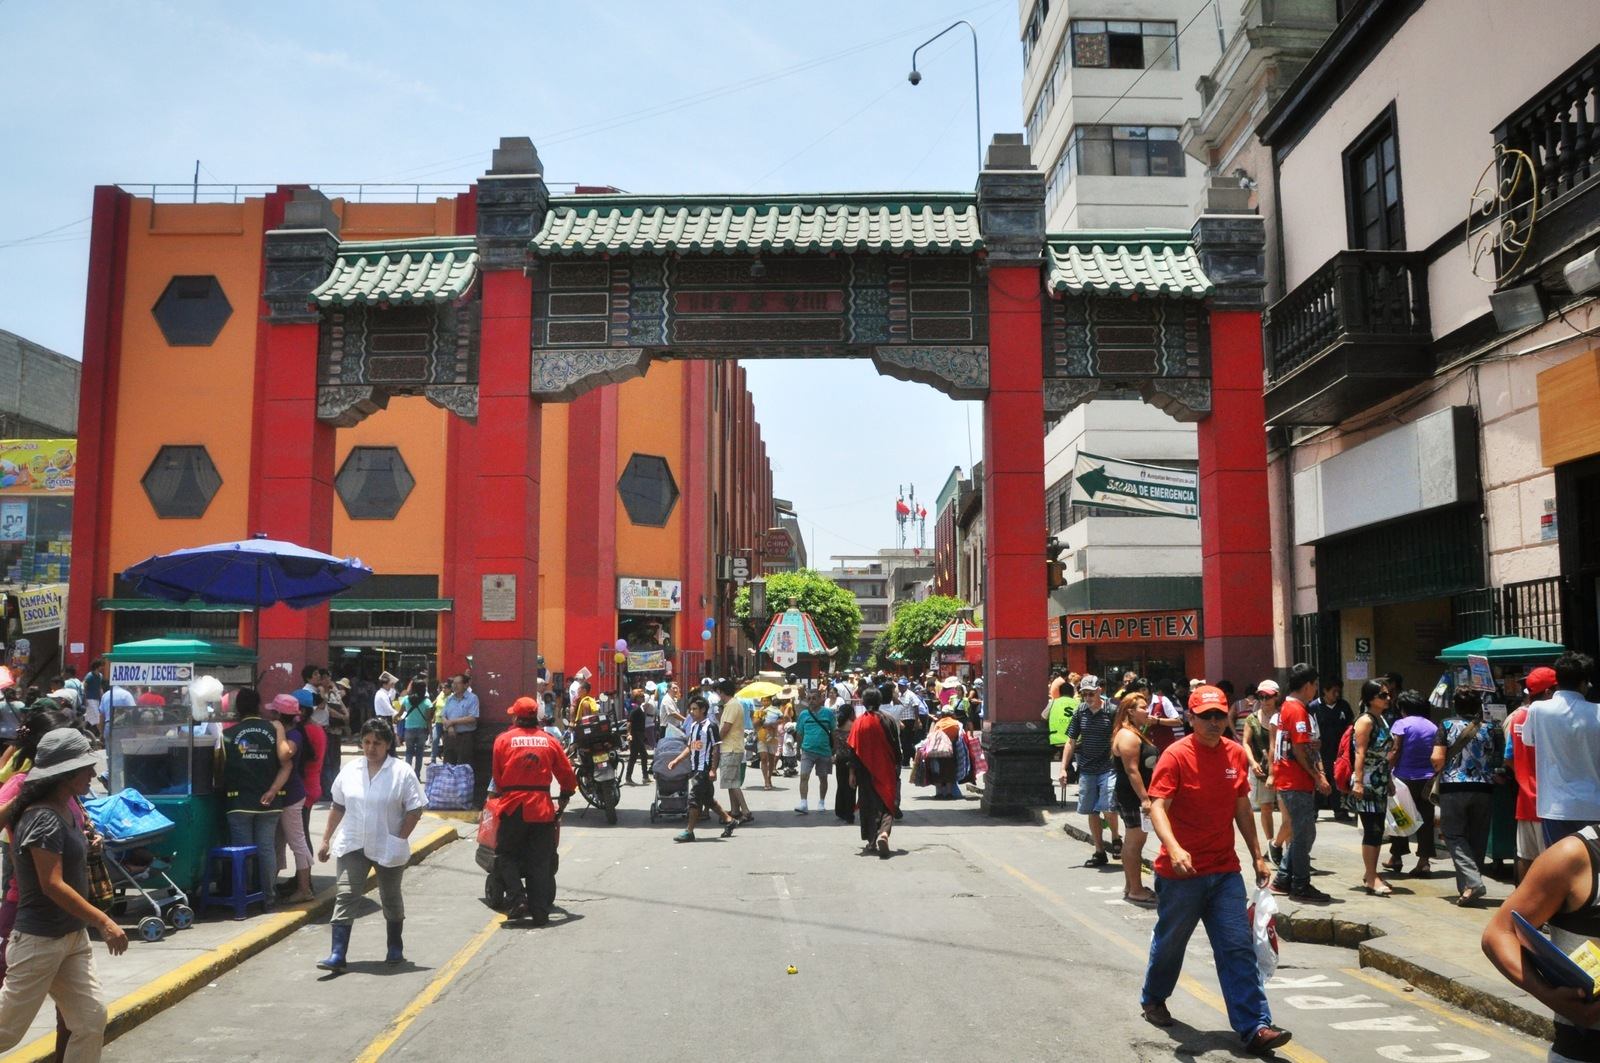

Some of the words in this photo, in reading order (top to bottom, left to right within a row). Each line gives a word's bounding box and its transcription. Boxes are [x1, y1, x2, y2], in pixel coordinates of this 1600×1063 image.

[1106, 479, 1138, 495] SALIDA
[1138, 484, 1150, 497] DE
[1150, 486, 1195, 501] EMERGENCIA
[766, 540, 789, 548] CHINA
[1069, 615, 1195, 639] CHAPPETEX
[112, 665, 141, 681] ARROZ
[151, 665, 177, 681] LECHE
